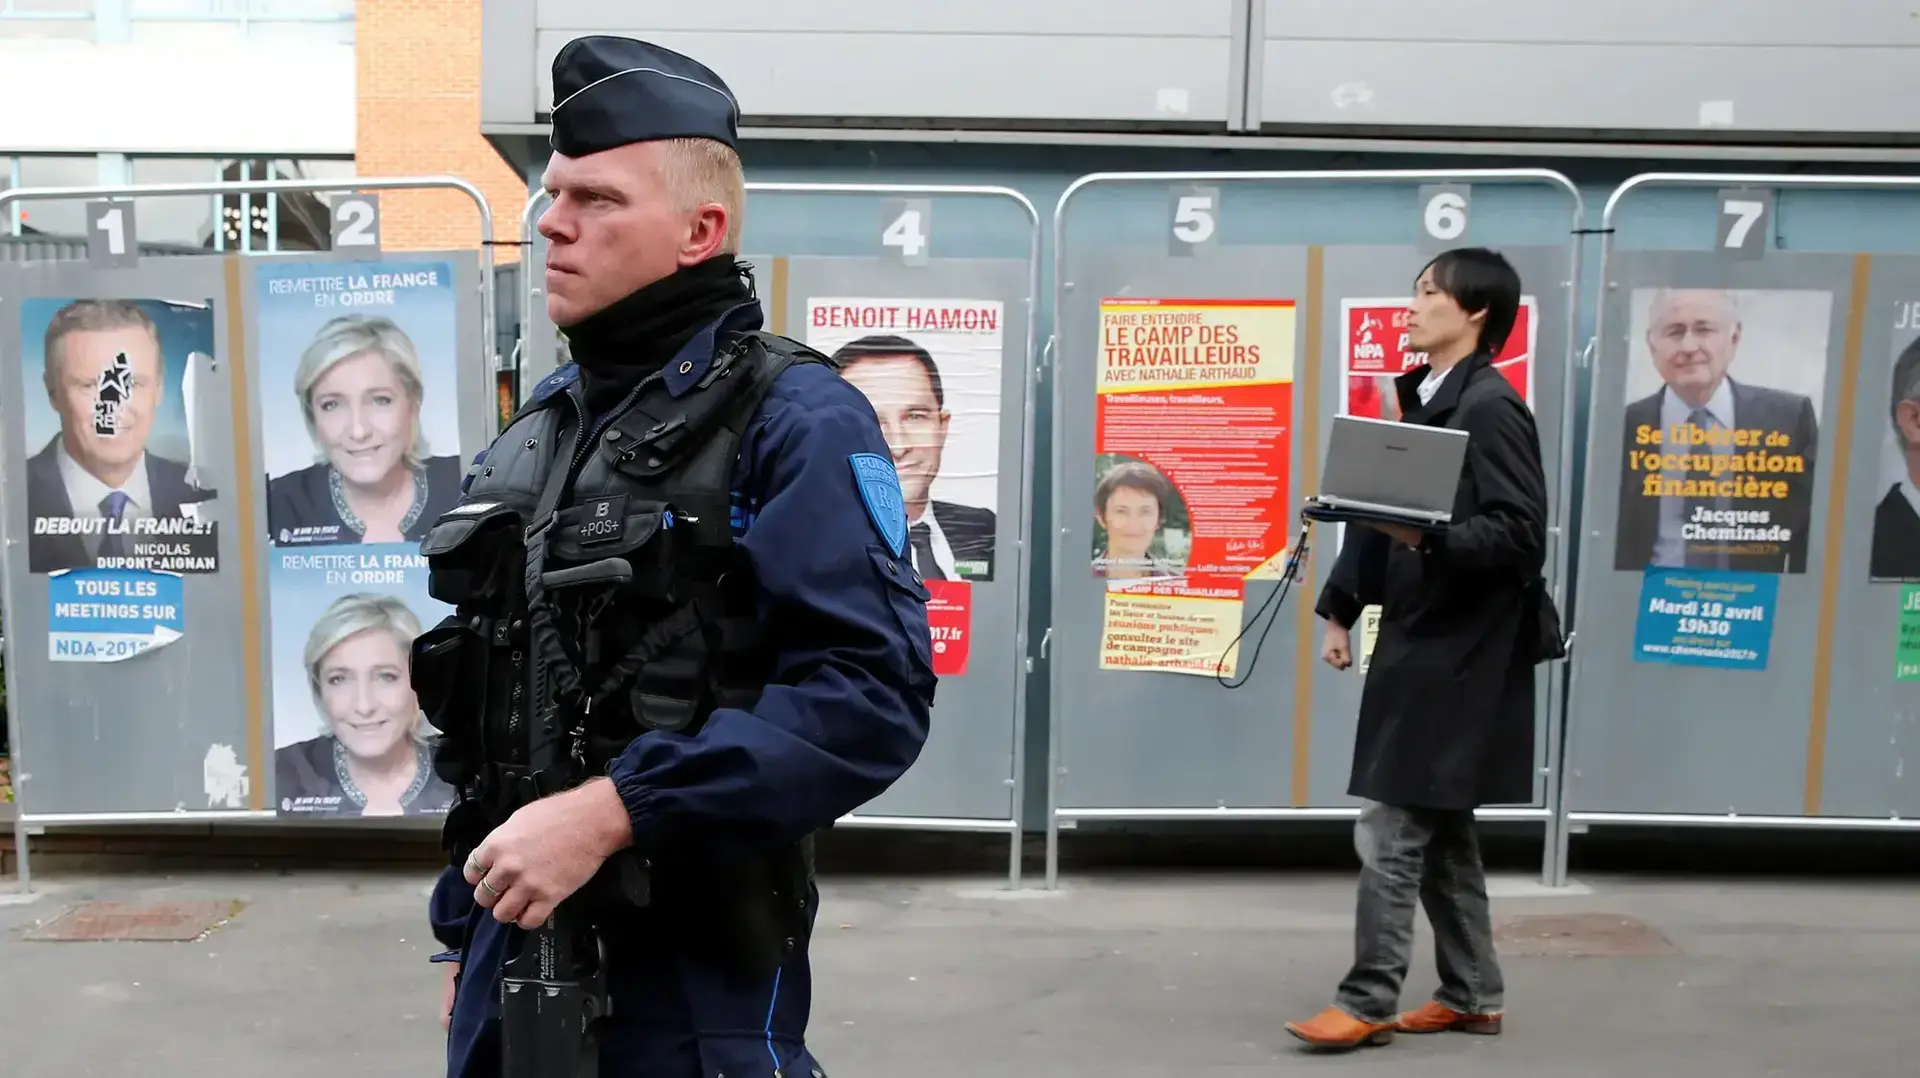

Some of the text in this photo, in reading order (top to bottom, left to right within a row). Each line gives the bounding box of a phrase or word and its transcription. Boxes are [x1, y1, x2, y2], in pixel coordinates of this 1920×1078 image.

[336, 200, 375, 246] 2
[1172, 196, 1215, 243] 5
[1423, 192, 1468, 241] 6
[1721, 201, 1765, 249] 7
[97, 209, 125, 254] 1
[883, 210, 926, 255] 4
[269, 272, 438, 294] REMETTRE LA FRANCE
[314, 290, 396, 307] EN ORDRE
[813, 307, 997, 330] BENOIT HAMON
[1104, 313, 1203, 327] FAIRE ENTENDRE
[1105, 325, 1238, 346] LE CAMP DES
[1104, 345, 1260, 367] TRAVAILLEURS
[1354, 343, 1384, 359] NPA
[1104, 367, 1256, 382] AVEC NATHALIE ARTHAUD
[1636, 424, 1790, 448] Se libérer de
[1630, 450, 1804, 476] l'occupation
[1642, 473, 1789, 498] financière
[595, 502, 610, 517] B
[1691, 506, 1770, 526] Jacques
[34, 517, 106, 534] DEBOUT
[107, 517, 130, 534] LA
[1681, 524, 1792, 541] Cheminade
[134, 543, 191, 556] NICOLAS
[96, 557, 216, 569] DUPONT-AIGNAN
[282, 555, 356, 569] REMETTRE
[359, 555, 379, 569] LA
[326, 570, 404, 584] EN ORDRE
[75, 580, 157, 596] TOUS LES
[55, 603, 176, 620] MEETINGS SUR
[1649, 598, 1764, 621] Mardi 18 avril
[1677, 618, 1731, 635] 19h30
[1107, 633, 1200, 646] consultez le site
[1106, 641, 1120, 651] de
[1123, 644, 1183, 656] campagne
